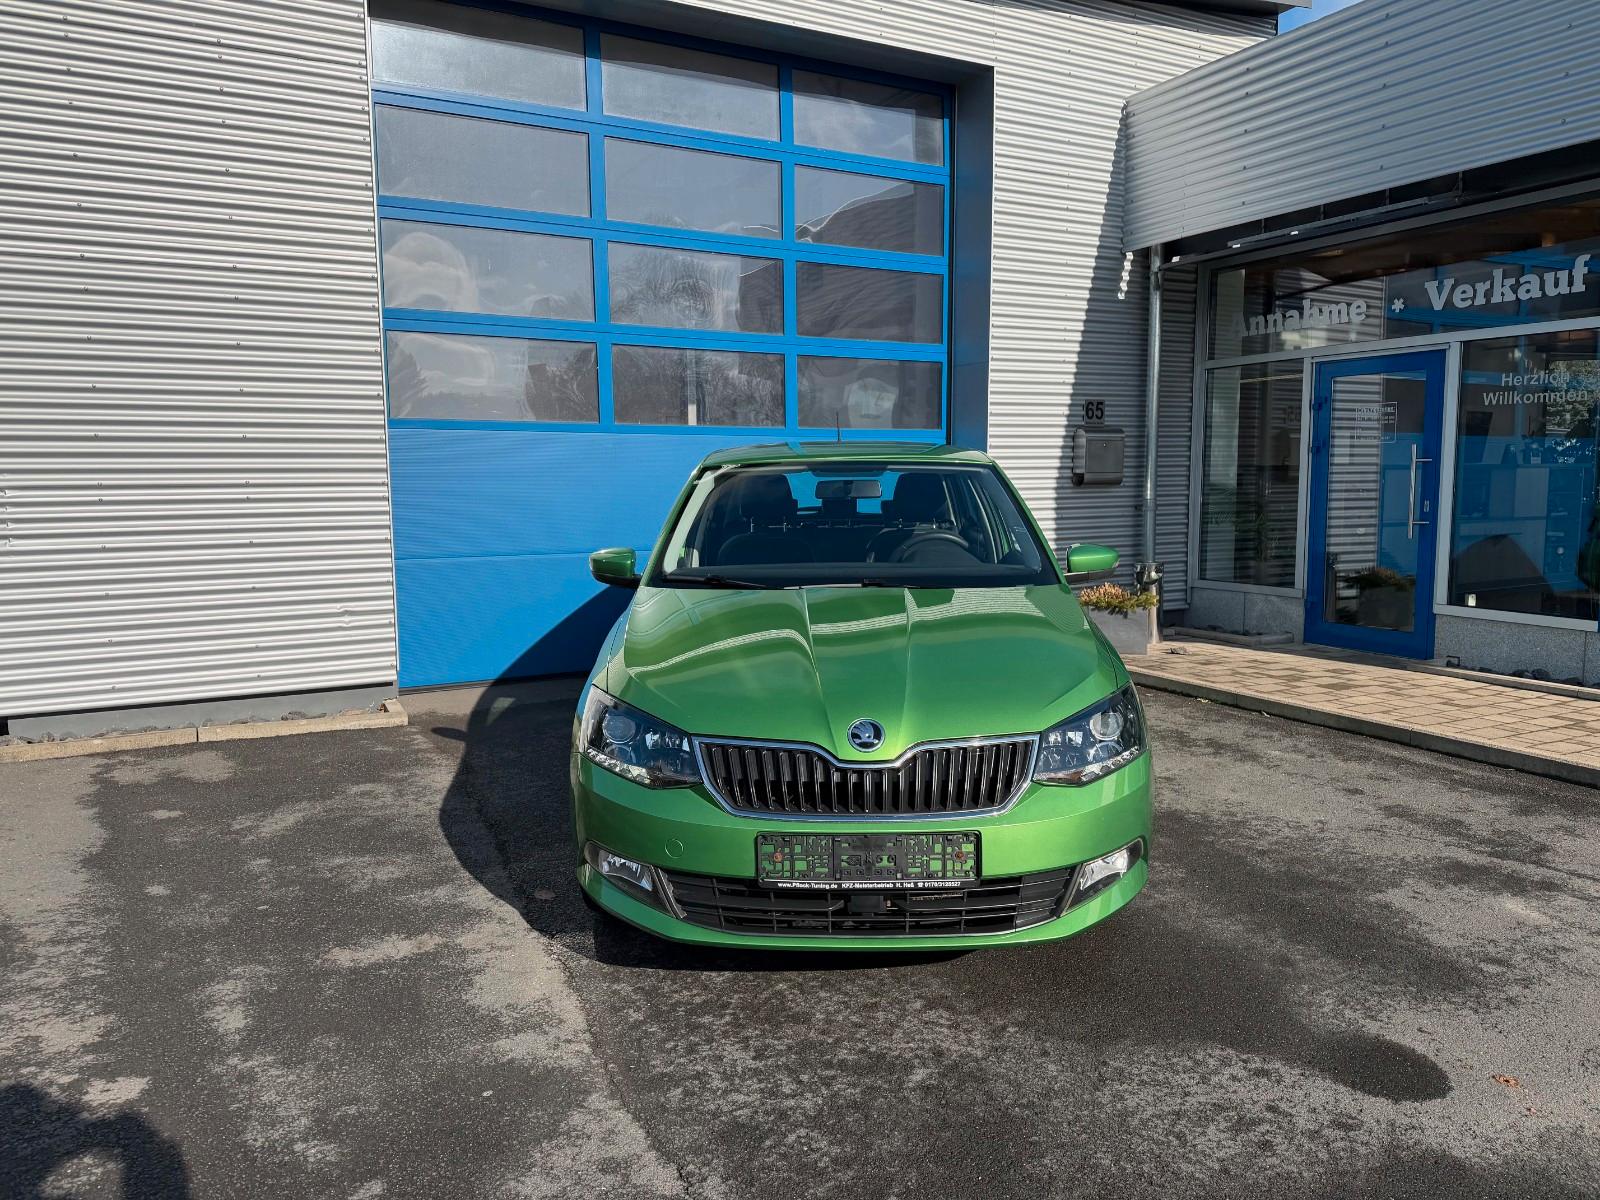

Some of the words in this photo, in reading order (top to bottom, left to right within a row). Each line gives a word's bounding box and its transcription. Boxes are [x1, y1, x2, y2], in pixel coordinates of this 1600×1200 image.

[1232, 299, 1367, 337] Annahme
[1424, 254, 1591, 311] Verkauf
[1501, 370, 1570, 387] Herzlich
[1483, 389, 1588, 406] Willkommen
[1085, 401, 1104, 420] 65
